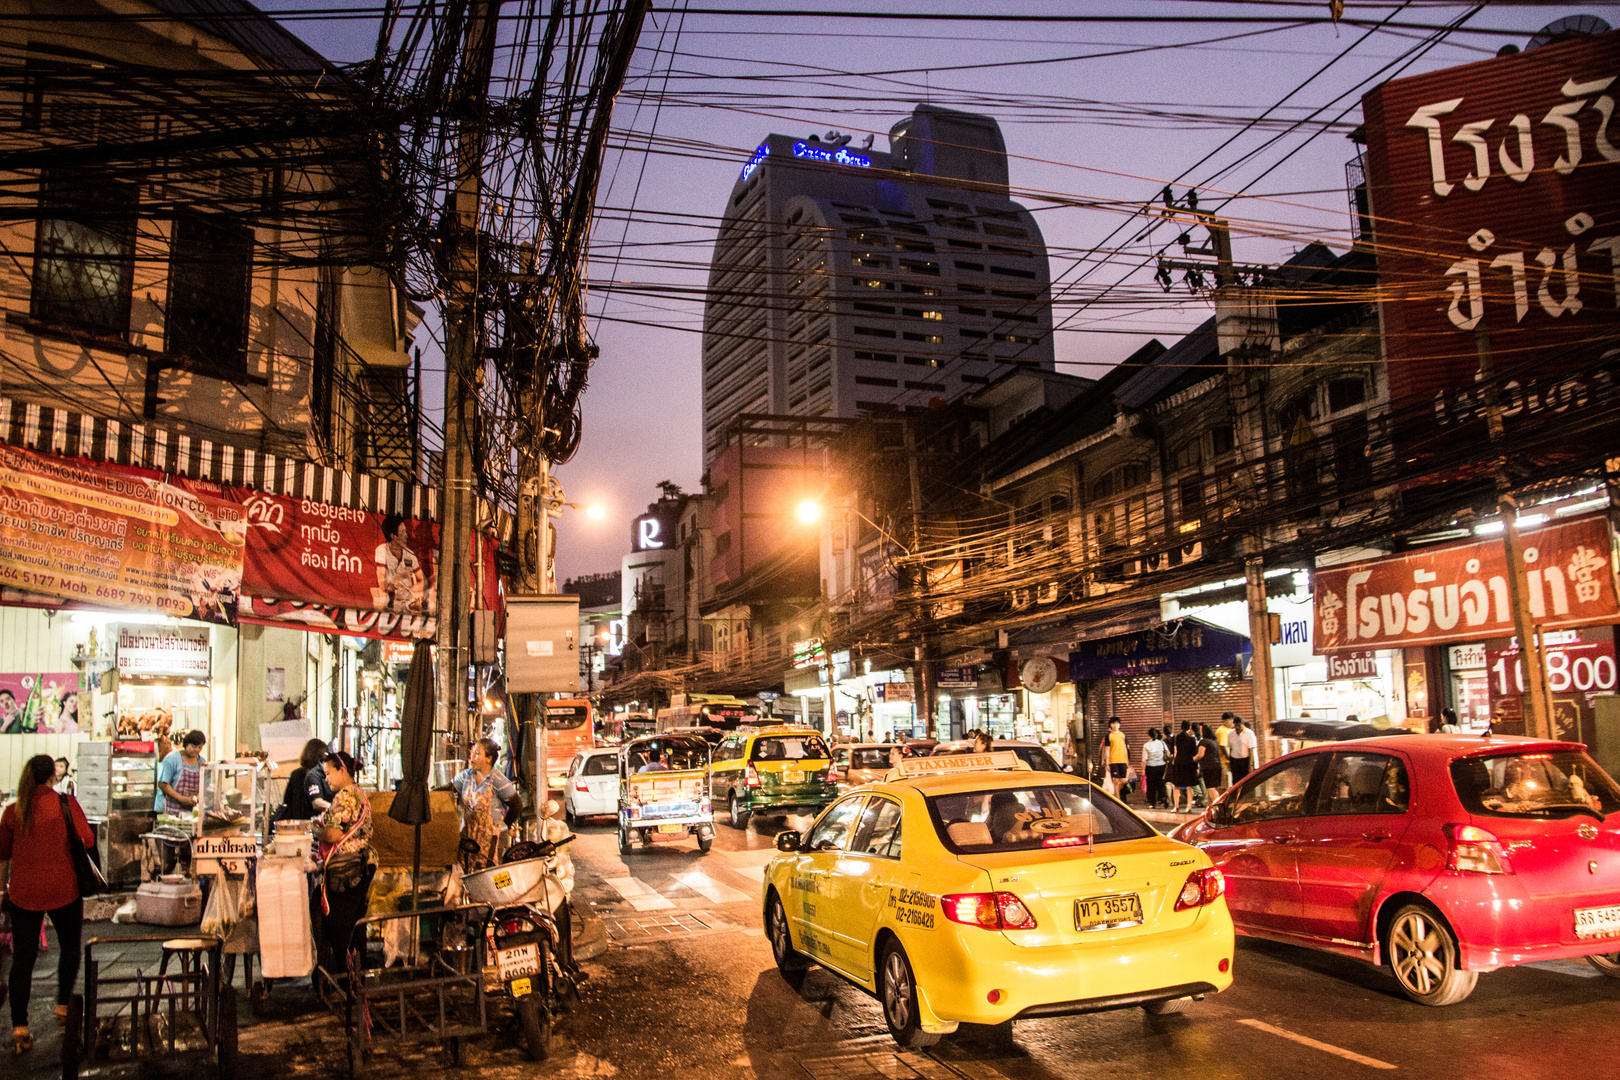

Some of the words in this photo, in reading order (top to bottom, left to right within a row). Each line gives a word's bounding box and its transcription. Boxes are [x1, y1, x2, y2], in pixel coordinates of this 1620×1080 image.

[105, 478, 184, 508] EDUCATION
[302, 520, 340, 546] ทุกมื้อ
[640, 518, 664, 549] R
[302, 547, 327, 569] ต้อง
[330, 547, 362, 574] โค้ก
[23, 571, 55, 587] 5177
[60, 579, 90, 594] Mob.
[96, 585, 125, 601] 6689
[130, 592, 152, 605] 799
[157, 597, 186, 611] 0093
[1330, 652, 1375, 676] โรงจำนำ
[916, 757, 994, 770] TAXI-METER
[1080, 902, 1100, 917] ทว
[1105, 898, 1134, 914] 3557
